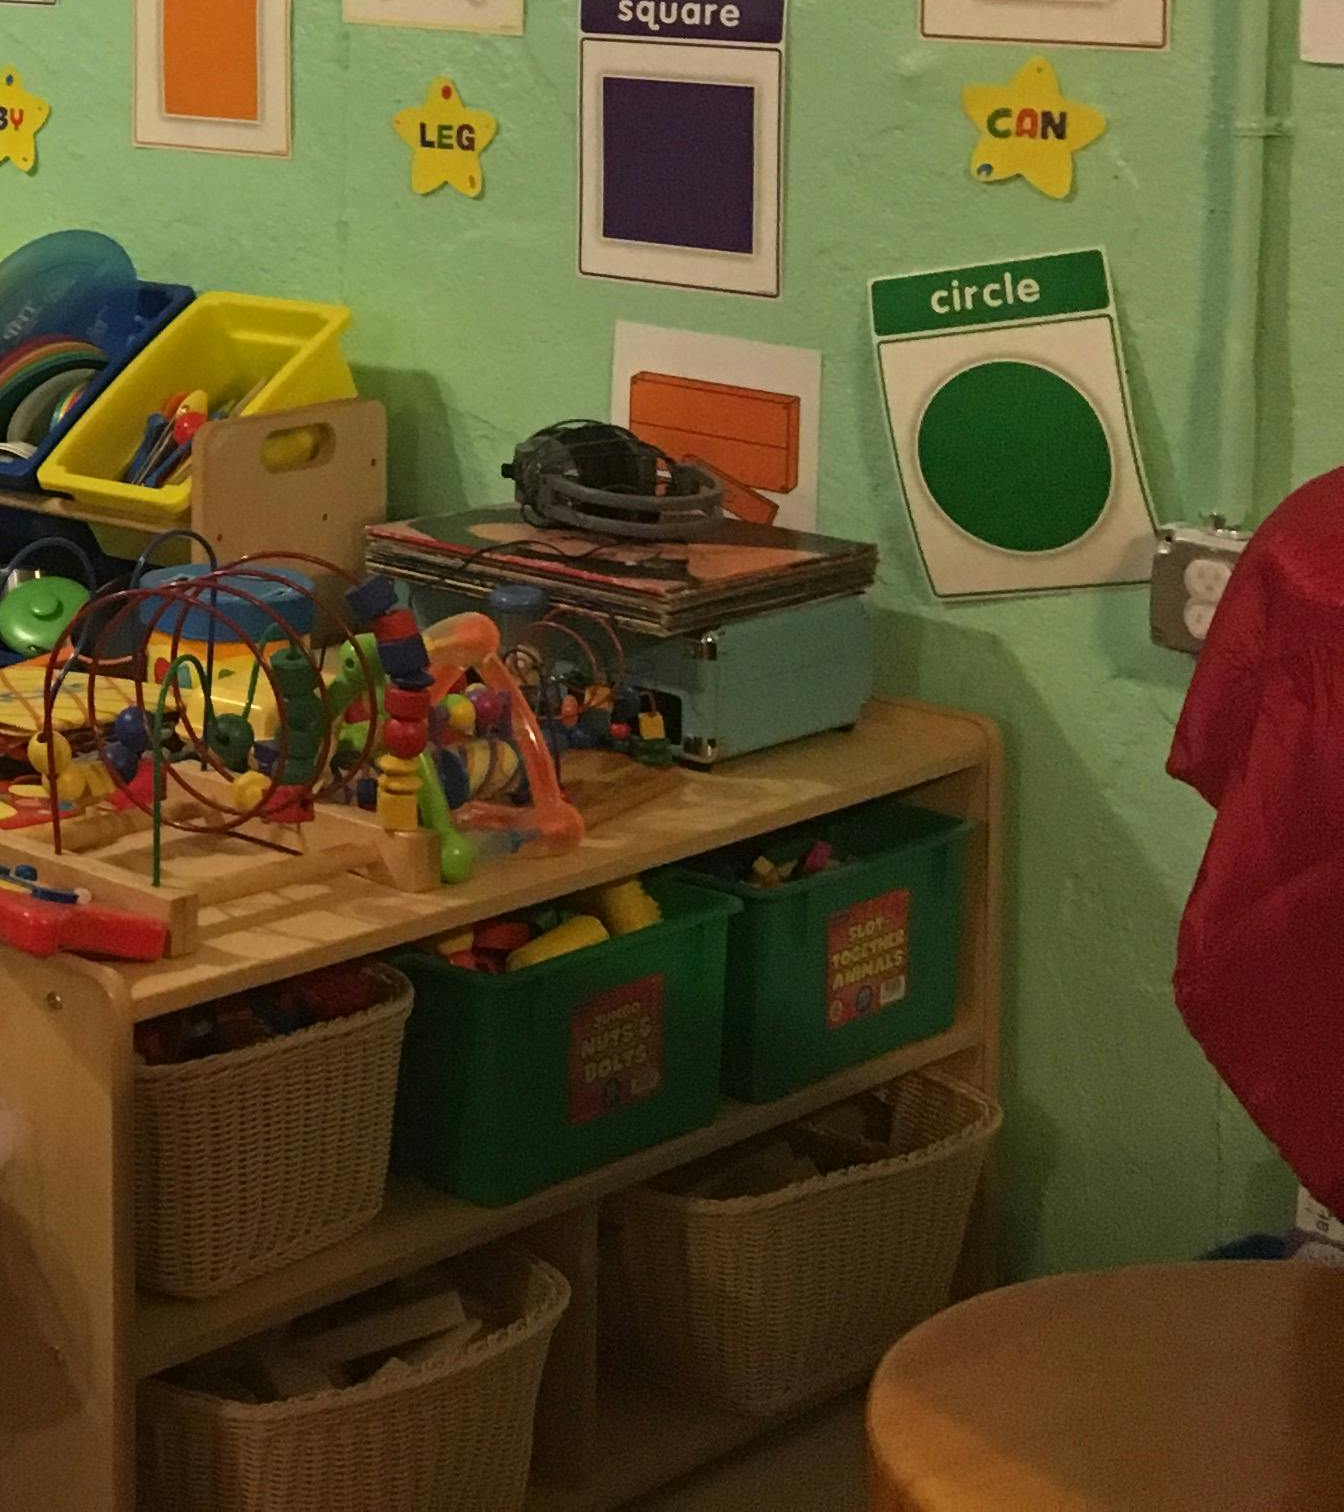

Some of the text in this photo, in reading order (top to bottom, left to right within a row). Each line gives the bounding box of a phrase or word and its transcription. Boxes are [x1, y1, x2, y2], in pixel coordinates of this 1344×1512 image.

[419, 122, 476, 152] LEG
[986, 106, 1068, 141] CAN
[930, 273, 1042, 314] circle
